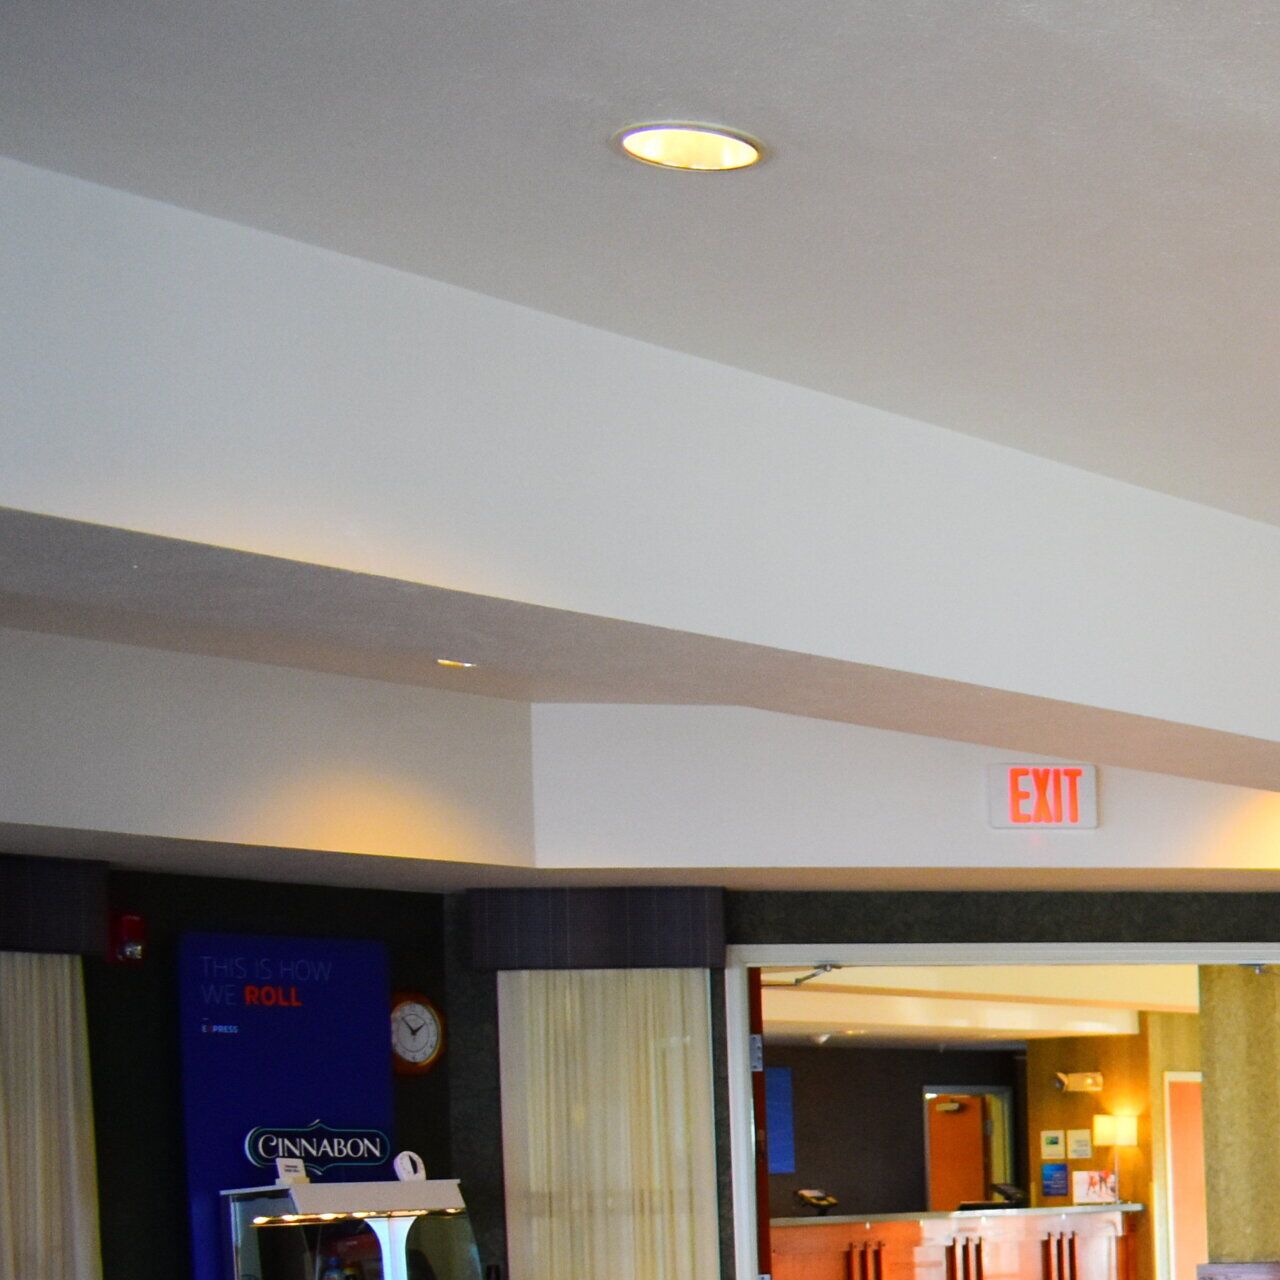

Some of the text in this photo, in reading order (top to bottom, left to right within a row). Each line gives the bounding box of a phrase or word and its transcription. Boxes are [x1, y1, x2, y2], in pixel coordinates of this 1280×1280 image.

[1008, 767, 1083, 824] EXIT
[200, 956, 333, 981] THIS IS HOW
[201, 984, 304, 1007] WE ROLL
[258, 1134, 381, 1159] CINNABON
